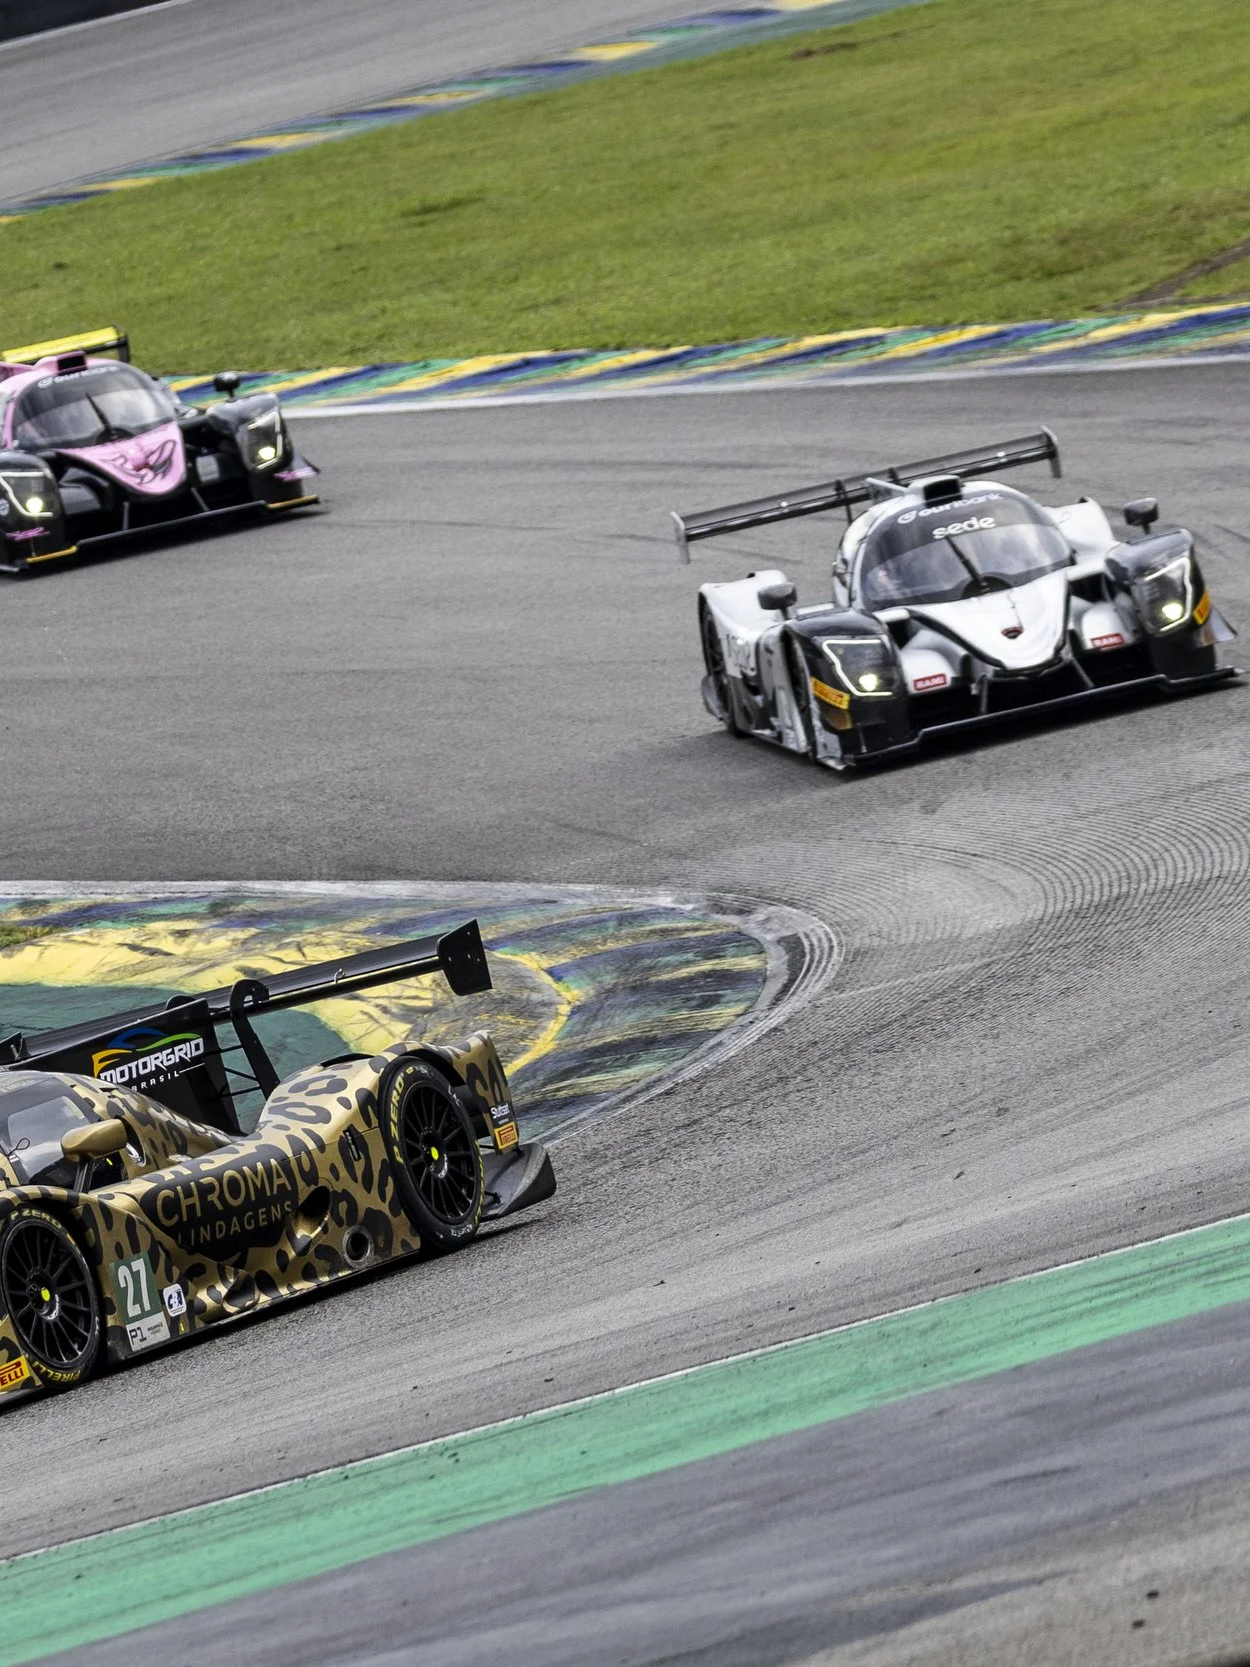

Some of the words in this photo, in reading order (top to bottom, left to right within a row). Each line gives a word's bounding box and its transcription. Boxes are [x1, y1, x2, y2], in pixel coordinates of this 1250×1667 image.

[932, 516, 996, 540] sede
[99, 1037, 204, 1085] MOTORGRID
[156, 1158, 292, 1228] CHROMA
[21, 1208, 63, 1230] ZERO
[117, 1258, 151, 1318] 27
[129, 1326, 147, 1346] P1
